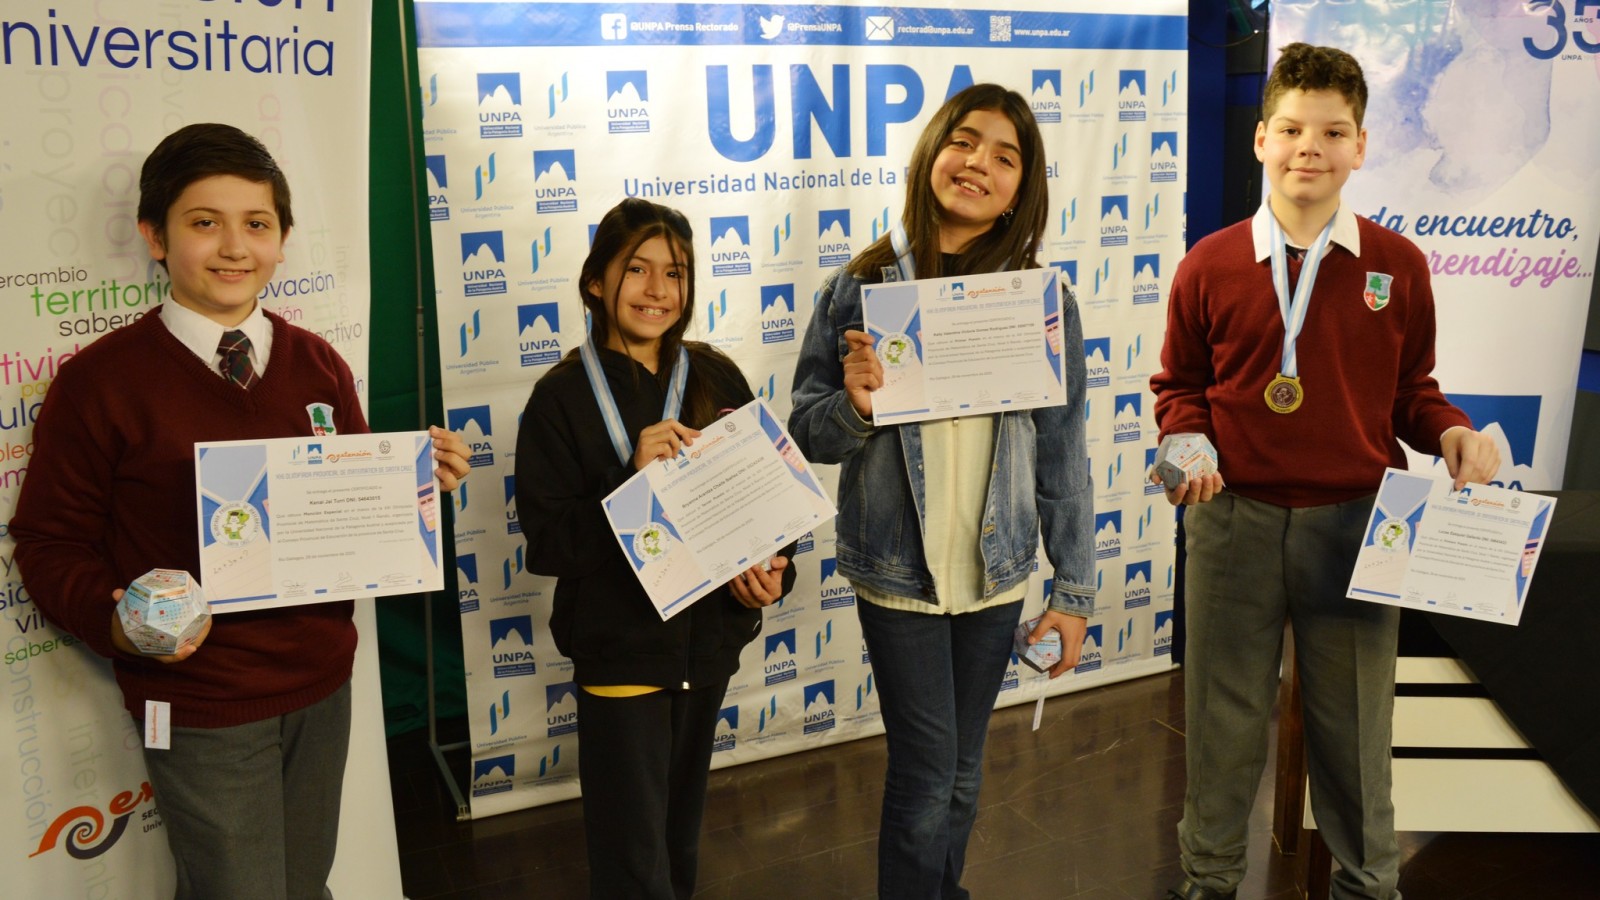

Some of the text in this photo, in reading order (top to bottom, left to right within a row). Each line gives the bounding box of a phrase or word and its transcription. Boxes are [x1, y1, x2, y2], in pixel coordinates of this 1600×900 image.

[665, 22, 694, 32] Prensa
[696, 22, 739, 32] Rectorado
[1014, 28, 1071, 38] www.unpa.edu.ar
[2, 9, 335, 76] niversitaria
[1032, 102, 1061, 110] UNPA
[1119, 101, 1145, 109] UNPA
[480, 112, 522, 122] UNPA
[608, 108, 649, 118] UNPA
[1151, 162, 1177, 170] UNPA
[624, 173, 756, 198] Universidad
[764, 169, 845, 191] Nacional
[850, 168, 873, 186] de
[879, 167, 897, 185] la
[536, 188, 576, 198] UNPA
[1101, 226, 1128, 234] UNPA
[1415, 209, 1578, 241] encuentro,
[818, 243, 851, 253] UNPA
[712, 251, 750, 262] UNPA
[463, 269, 505, 281] UNPA
[1133, 284, 1159, 292] UNPA
[762, 318, 794, 330] UNPA
[520, 339, 560, 352] UNPA
[1114, 422, 1140, 432] UNPA
[821, 587, 855, 598] UNPA
[1125, 588, 1150, 598] UNPA
[493, 651, 534, 663] UNPA
[764, 660, 796, 674] UNPA
[804, 710, 834, 723] UNPA
